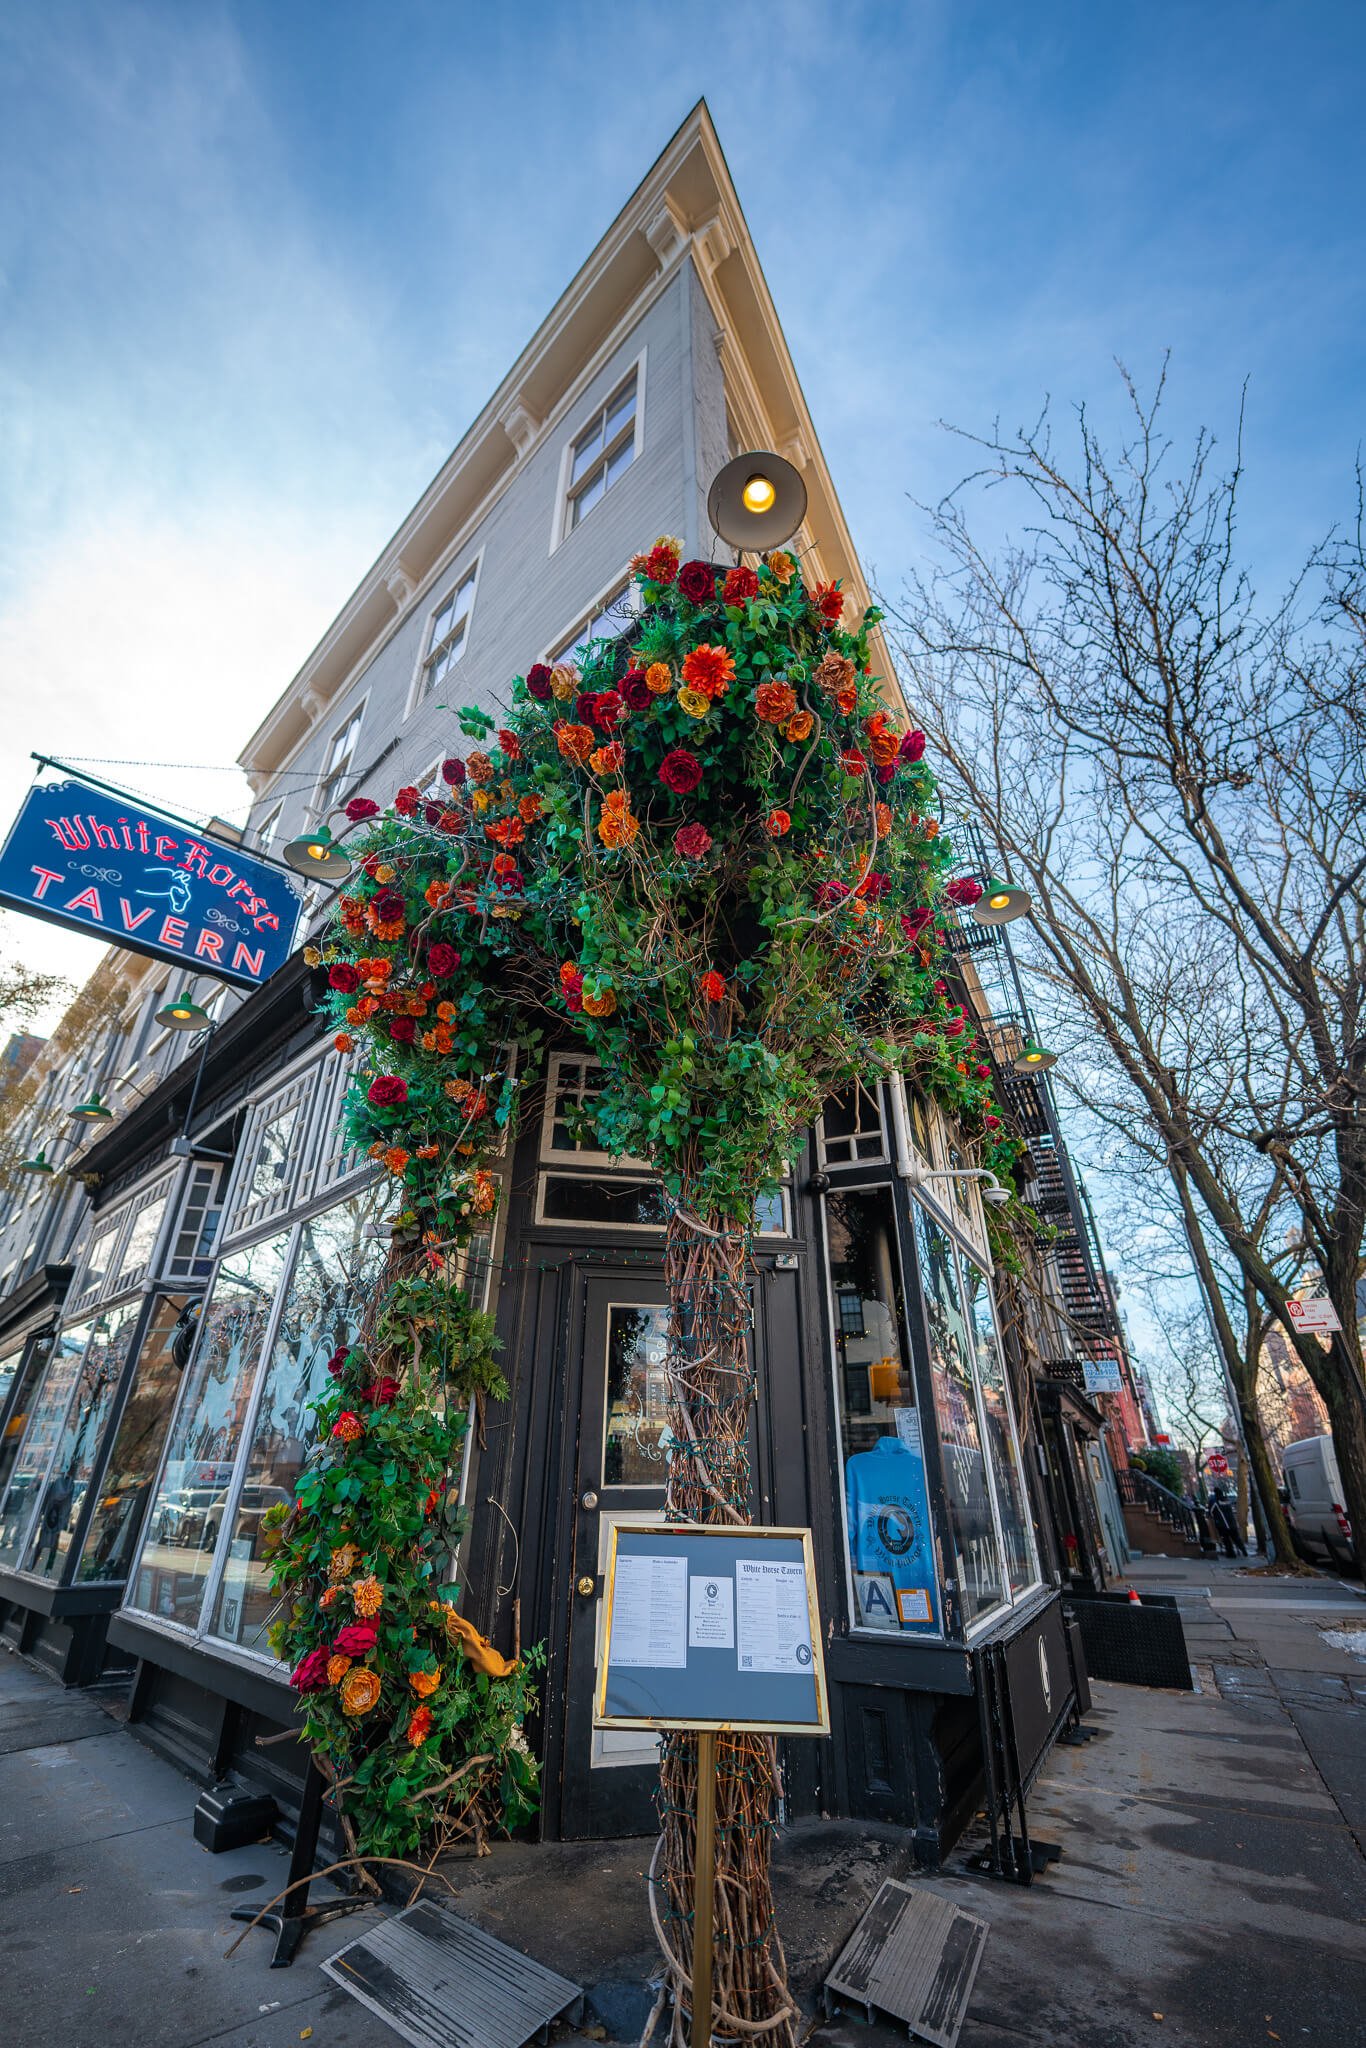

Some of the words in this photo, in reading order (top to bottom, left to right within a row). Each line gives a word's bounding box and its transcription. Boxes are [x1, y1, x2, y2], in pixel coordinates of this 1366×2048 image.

[45, 814, 178, 860] White
[178, 840, 279, 932] Horse
[30, 865, 265, 976] TAVERN
[742, 1564, 761, 1573] White
[762, 1565, 780, 1574] Horse
[781, 1566, 803, 1575] Tavern
[865, 1581, 892, 1615] A
